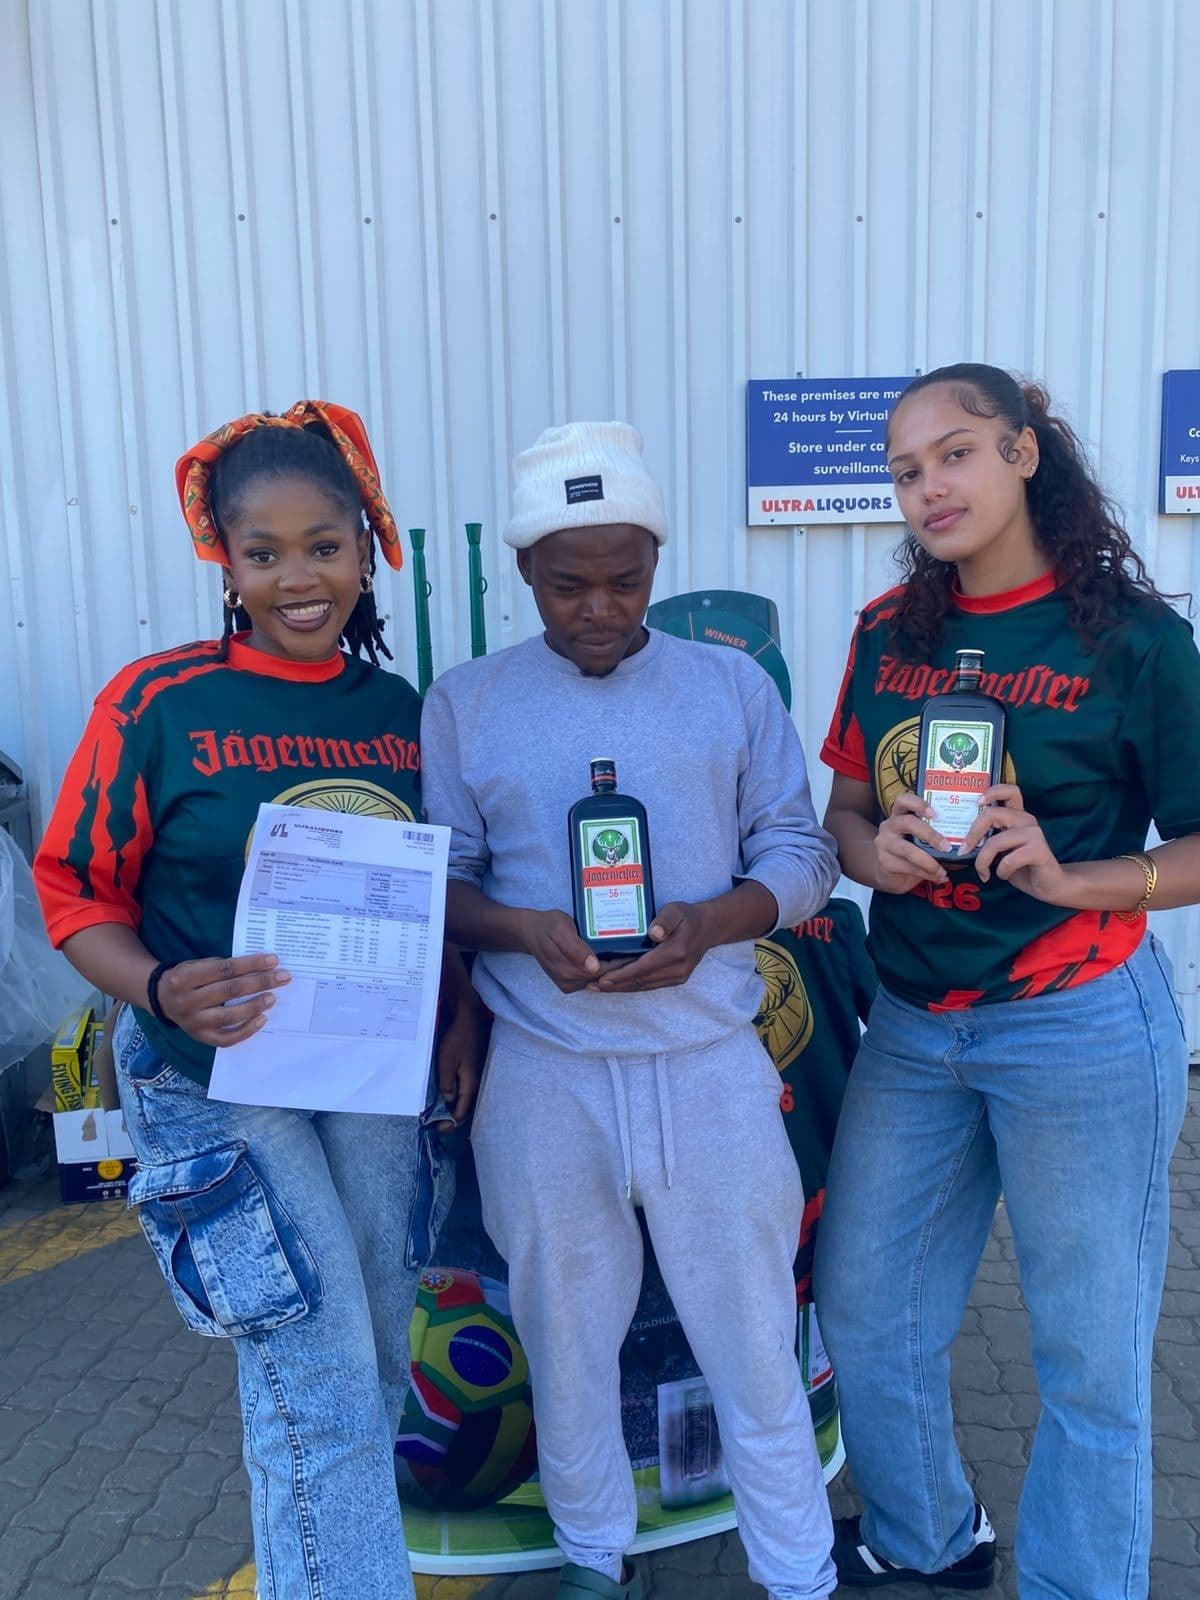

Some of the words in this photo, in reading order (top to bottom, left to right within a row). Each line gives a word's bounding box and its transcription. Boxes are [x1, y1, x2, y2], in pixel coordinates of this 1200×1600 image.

[762, 390, 798, 402] These
[801, 389, 856, 403] premises
[859, 390, 880, 400] are
[773, 412, 789, 423] 24
[792, 411, 826, 423] hours
[829, 410, 845, 424] by
[847, 409, 889, 421] Virtual
[788, 441, 823, 454] Store
[827, 440, 867, 452] under
[1180, 454, 1200, 464] Keys
[761, 496, 893, 513] ULTRALIQUORS
[704, 627, 748, 649] WINNER
